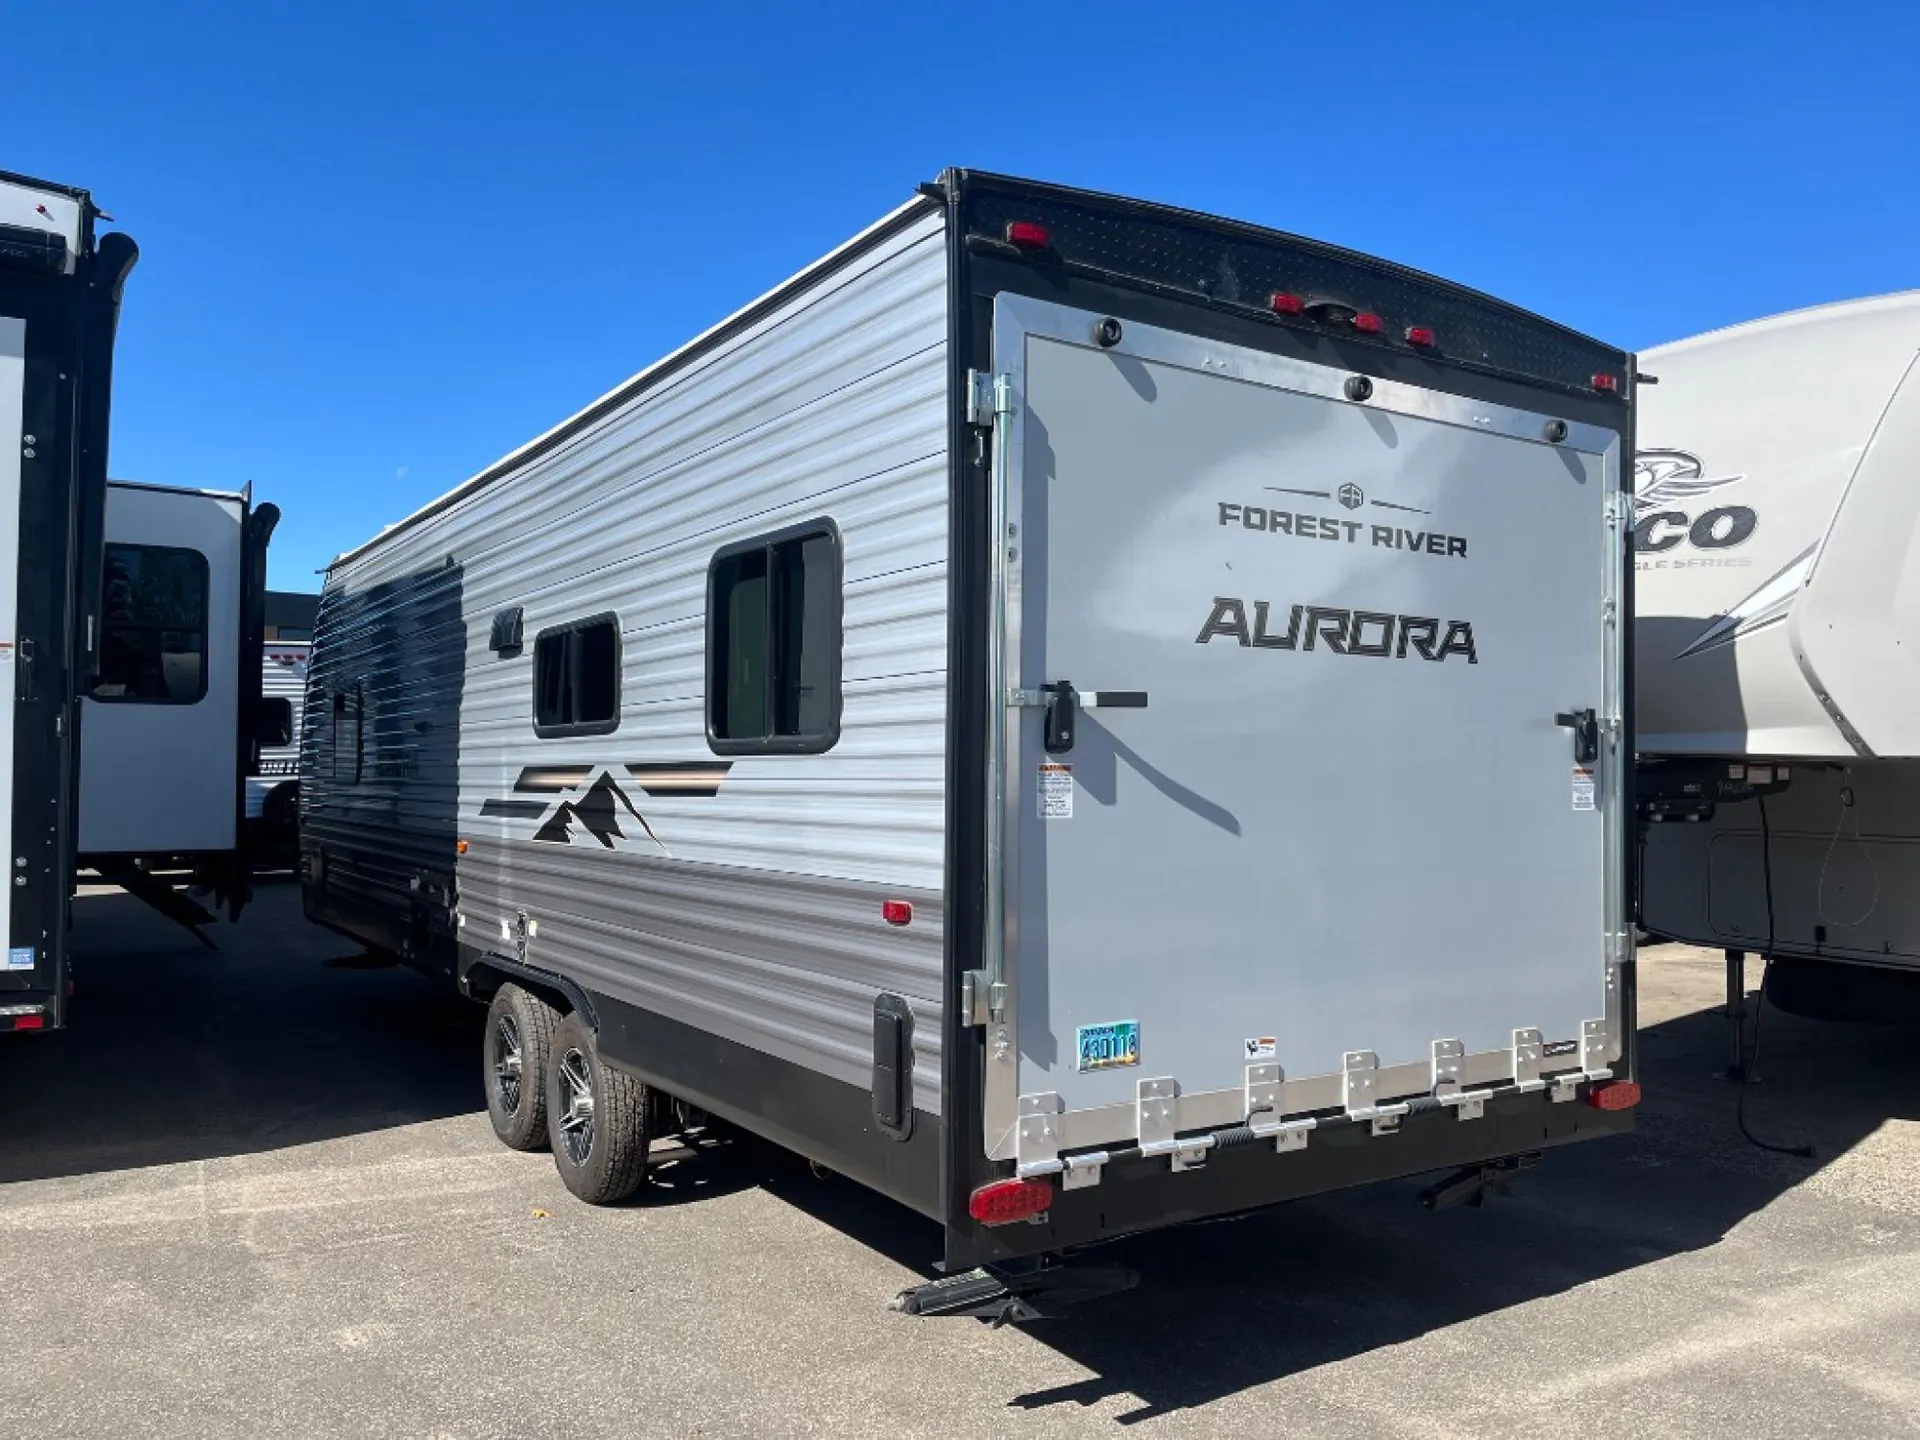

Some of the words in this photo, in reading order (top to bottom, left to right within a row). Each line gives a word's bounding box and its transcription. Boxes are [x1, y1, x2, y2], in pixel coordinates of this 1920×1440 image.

[1217, 501, 1363, 543] FOREST
[1370, 523, 1468, 559] RIVER
[1195, 596, 1479, 665] AURORA
